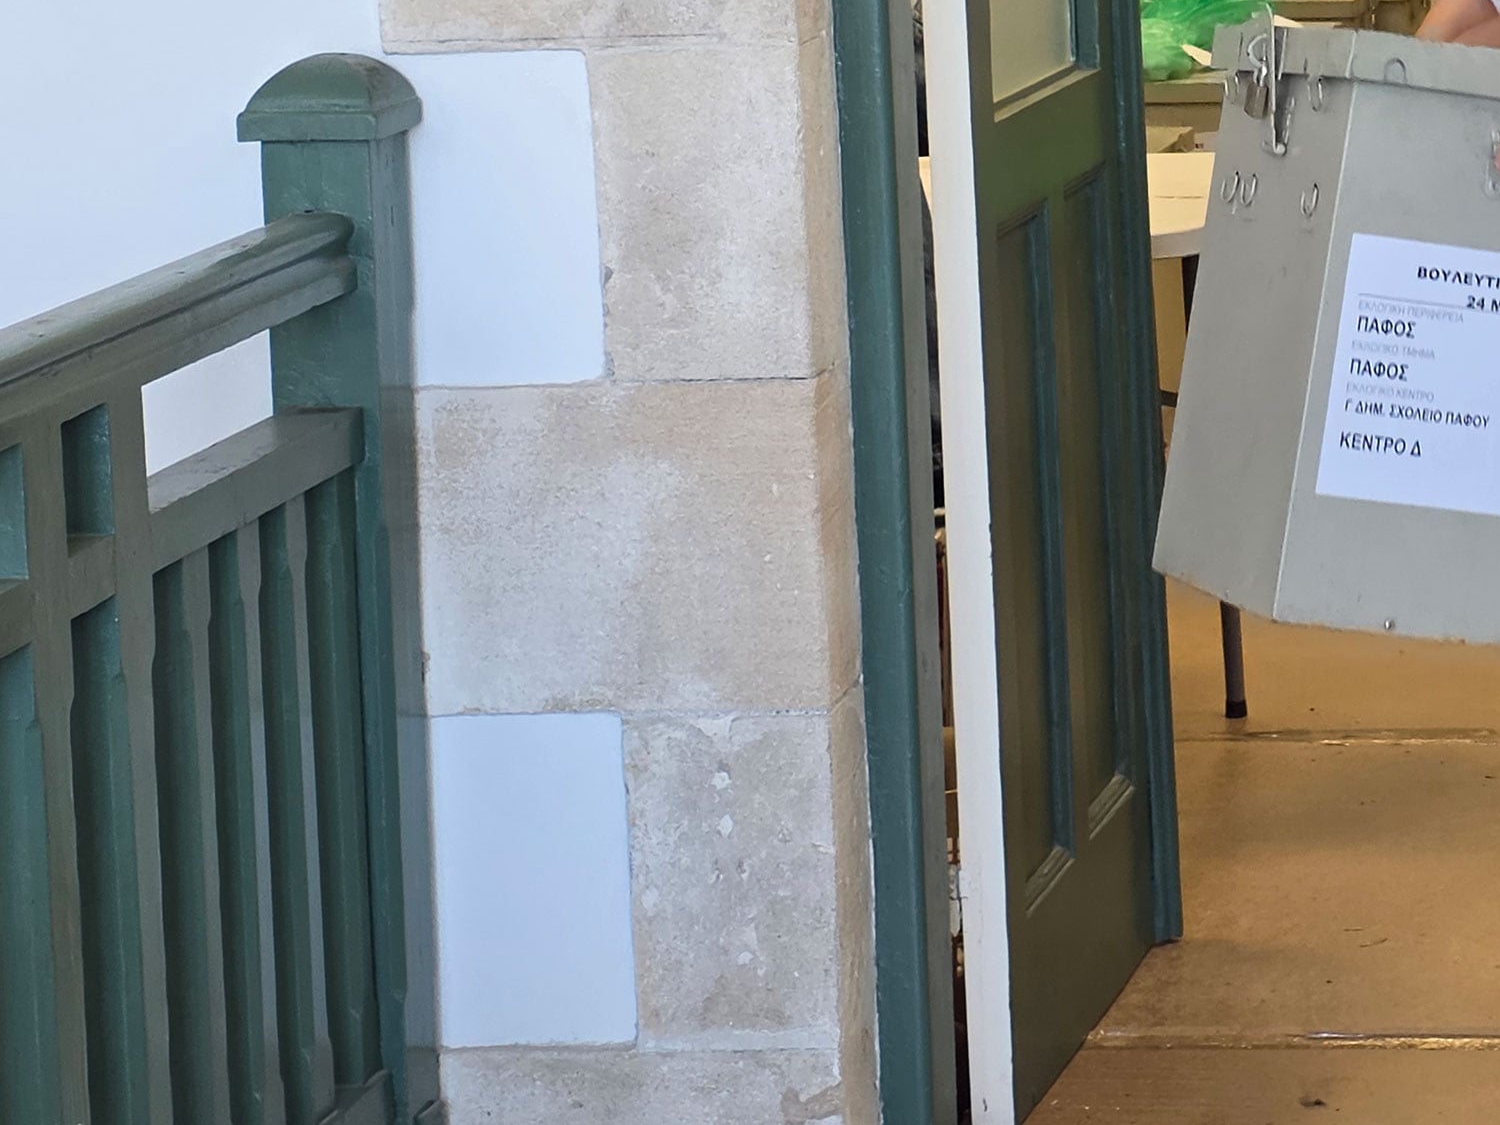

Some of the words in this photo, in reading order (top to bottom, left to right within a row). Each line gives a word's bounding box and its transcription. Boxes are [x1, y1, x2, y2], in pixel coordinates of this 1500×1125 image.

[1466, 295, 1485, 311] 24
[1357, 315, 1417, 339] ΠΑΦΟΣ
[1349, 358, 1409, 382] ΠΑΦΟΣ
[1389, 403, 1442, 424] ΣΧΟΛΕΙΟ
[1445, 411, 1490, 429] ΠΑΦΟΥ
[1339, 431, 1407, 455] ΚΕΝΤΡΟ
[1410, 440, 1422, 457] Δ
